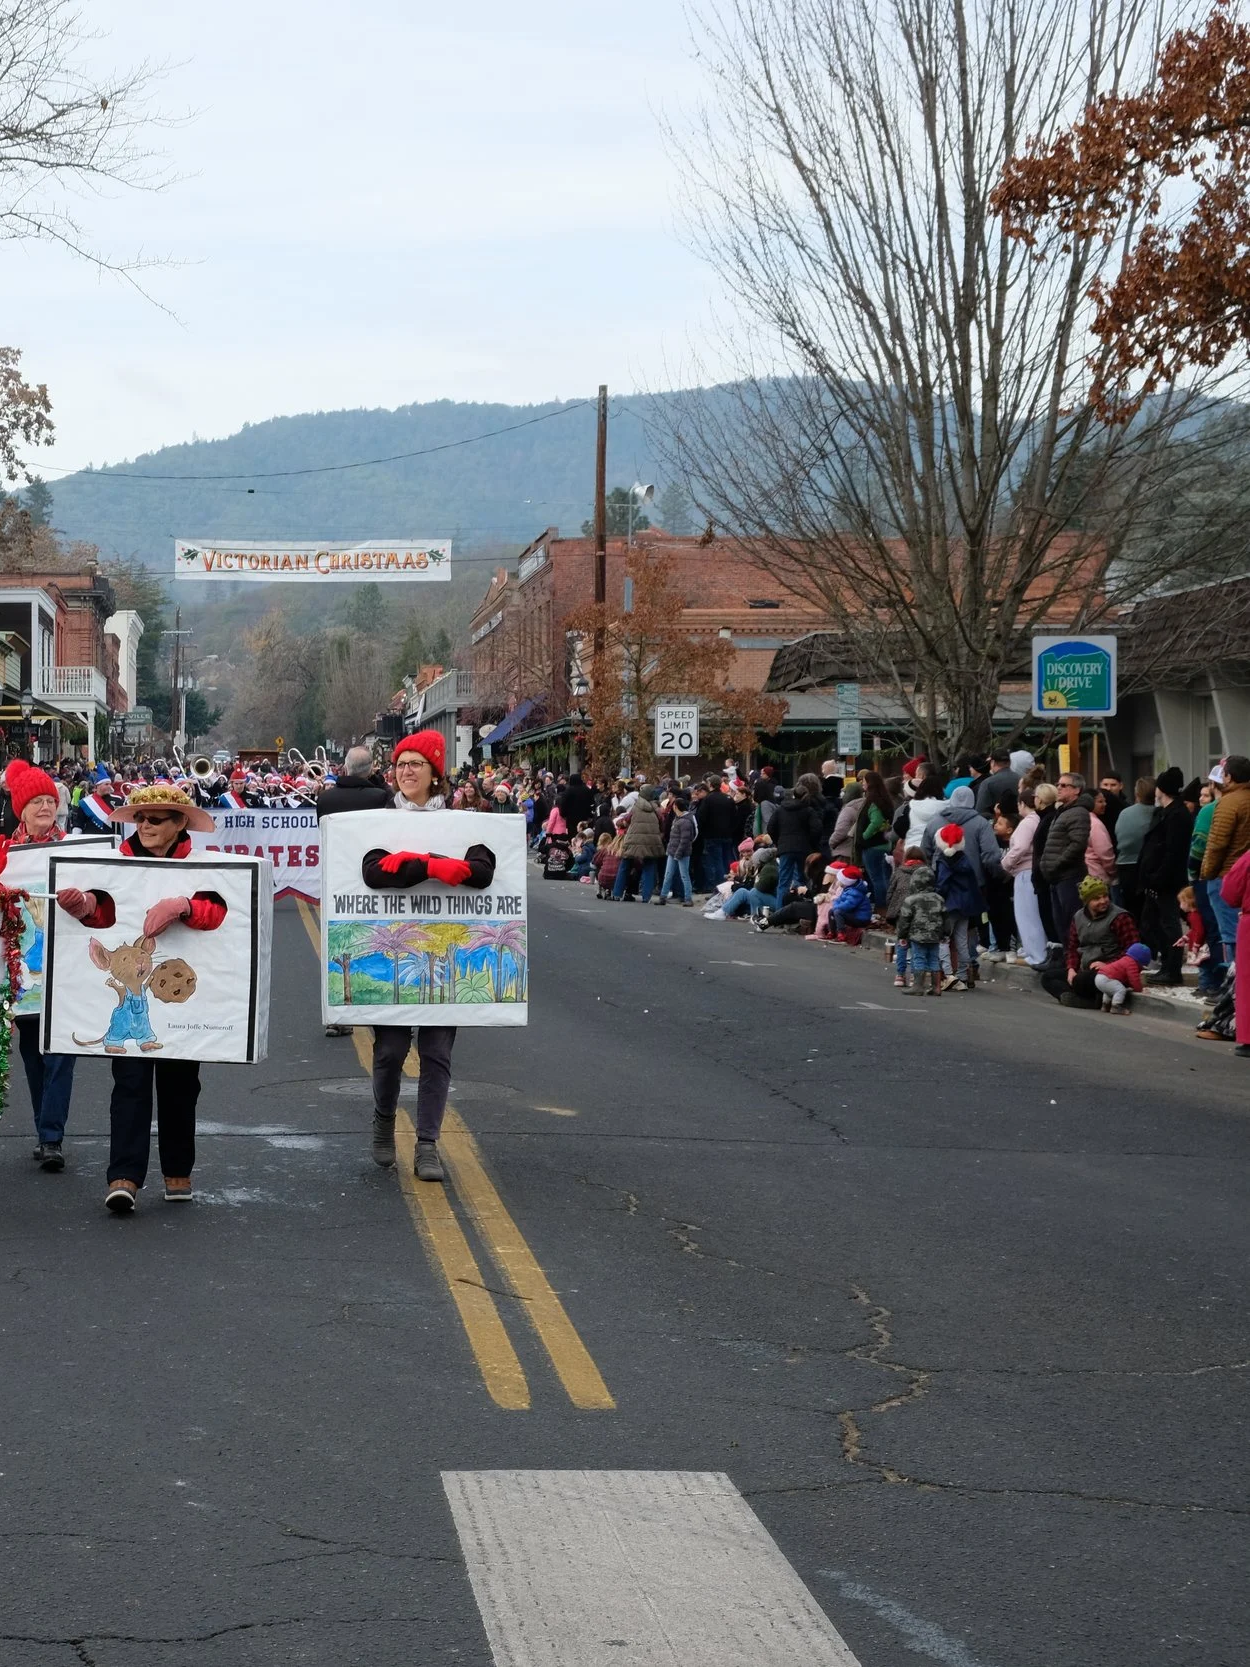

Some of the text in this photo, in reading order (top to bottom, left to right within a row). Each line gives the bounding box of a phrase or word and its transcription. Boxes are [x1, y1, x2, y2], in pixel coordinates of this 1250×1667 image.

[201, 550, 430, 575] VICTORIAN CHRISTMAS
[1046, 662, 1103, 676] DISCOVERY
[1057, 676, 1092, 689] DRIVE
[660, 710, 695, 719] SPEED
[663, 721, 690, 730] LIMIT
[660, 732, 693, 750] 20
[224, 815, 256, 828] HIGH
[262, 815, 318, 829] SCHOOL
[333, 894, 522, 916] WHERE THE WILD THINGS ARE
[167, 1022, 235, 1032] Laura Joffe Numeroff
